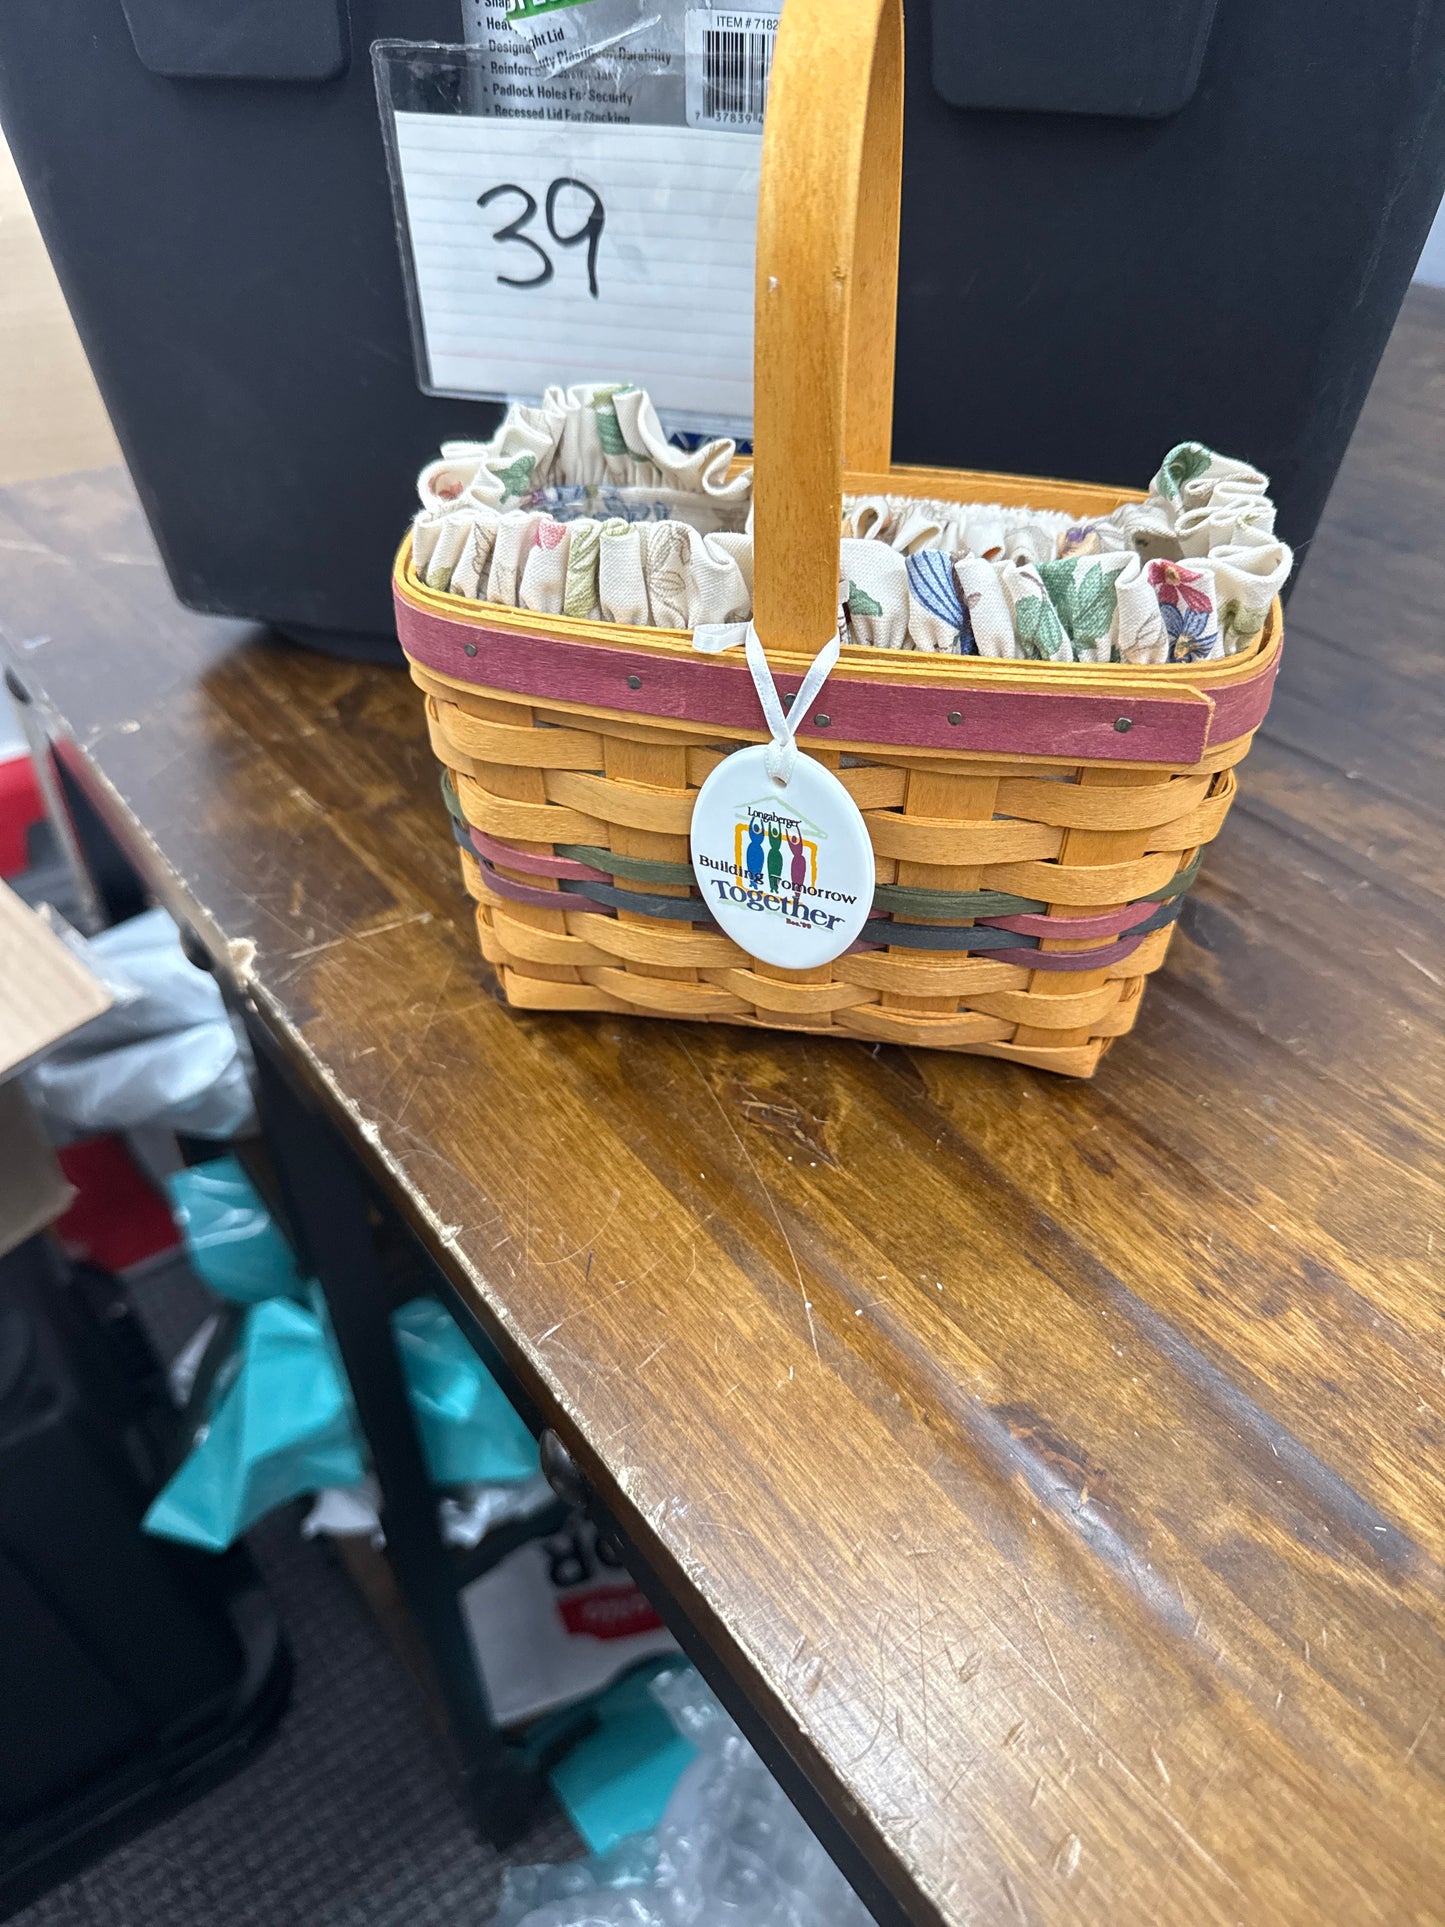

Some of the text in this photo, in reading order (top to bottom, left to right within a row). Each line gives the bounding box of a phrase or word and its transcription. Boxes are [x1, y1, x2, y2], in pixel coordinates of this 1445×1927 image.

[716, 15, 743, 28] ITEM
[745, 18, 752, 28] #
[546, 27, 565, 43] Lid
[492, 83, 535, 98] Padlock
[537, 86, 568, 101] Holes
[588, 89, 633, 107] Security
[494, 104, 545, 119] Recessed
[546, 108, 563, 121] Lid
[564, 108, 582, 121] For
[715, 112, 753, 125] 37839
[476, 177, 605, 298] 39
[747, 806, 802, 829] Longaberger
[699, 854, 857, 905] Building Tomorrow
[711, 879, 846, 931] Together
